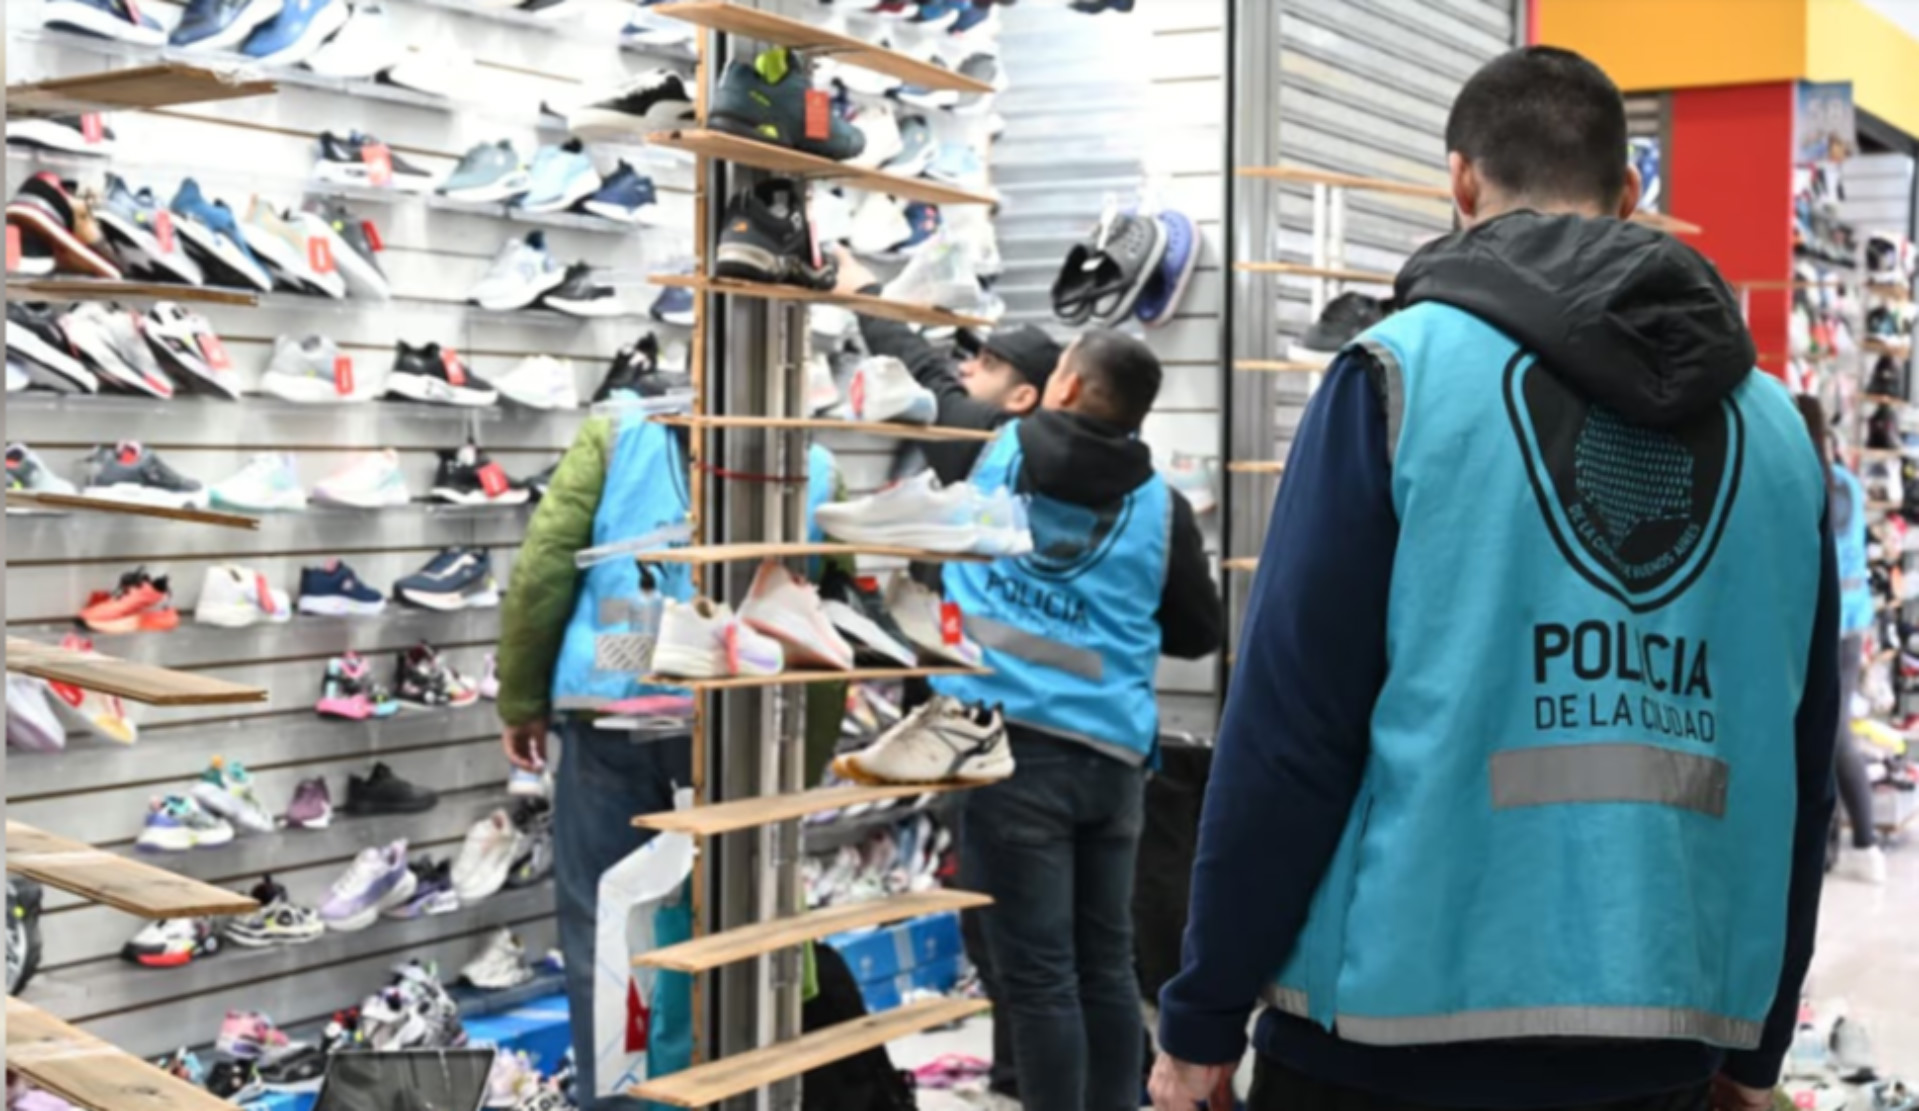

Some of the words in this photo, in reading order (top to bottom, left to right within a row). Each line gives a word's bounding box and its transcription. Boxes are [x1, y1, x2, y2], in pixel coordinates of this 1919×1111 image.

[1533, 619, 1712, 700] POLCIA
[1535, 694, 1579, 730] DE
[1589, 692, 1633, 727] LA
